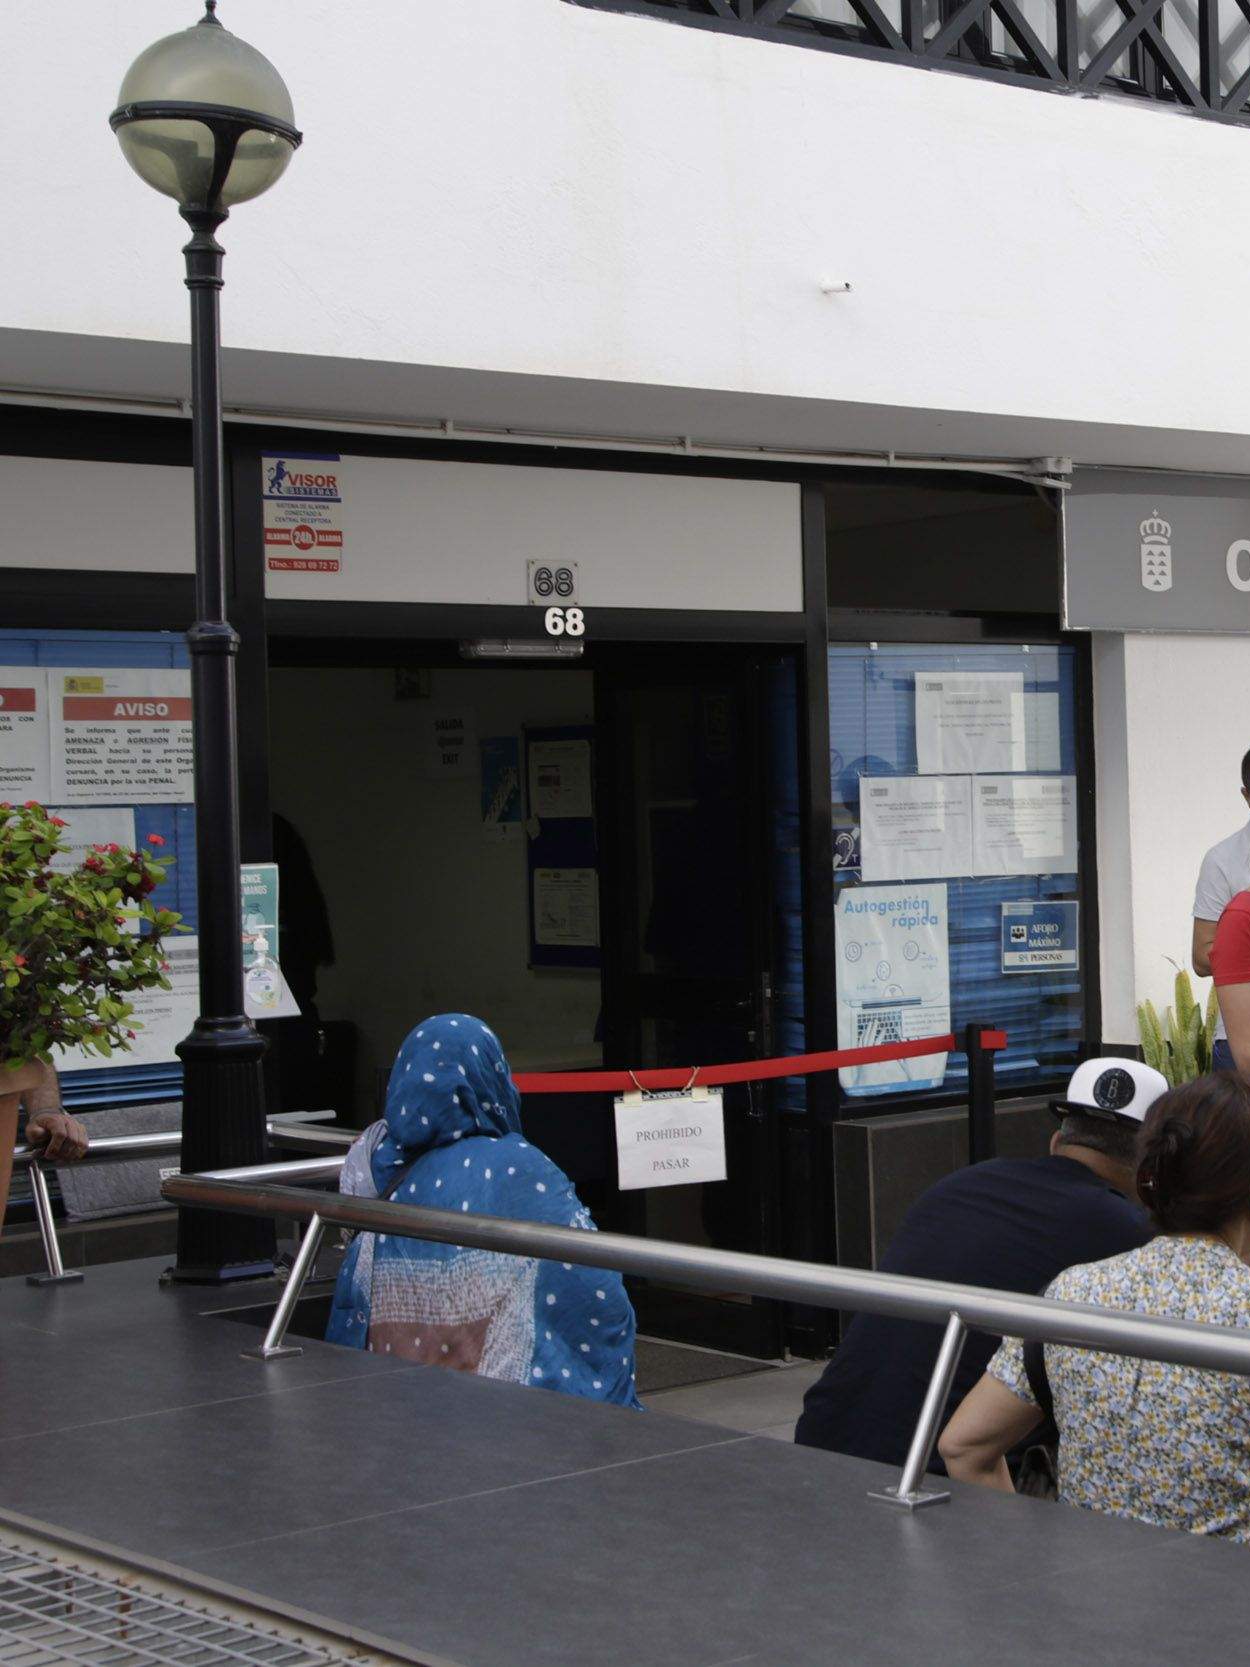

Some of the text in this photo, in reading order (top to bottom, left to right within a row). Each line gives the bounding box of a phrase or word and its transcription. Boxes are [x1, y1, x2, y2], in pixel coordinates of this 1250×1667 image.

[287, 473, 337, 488] VISOR
[533, 567, 574, 597] 68
[544, 606, 586, 636] 68
[114, 702, 169, 717] AVISO
[844, 896, 930, 916] Autogestión
[891, 912, 938, 930] rápida
[1031, 923, 1060, 934] AFORO
[635, 1126, 703, 1142] PROHIBIDO
[652, 1157, 691, 1171] PASAR
